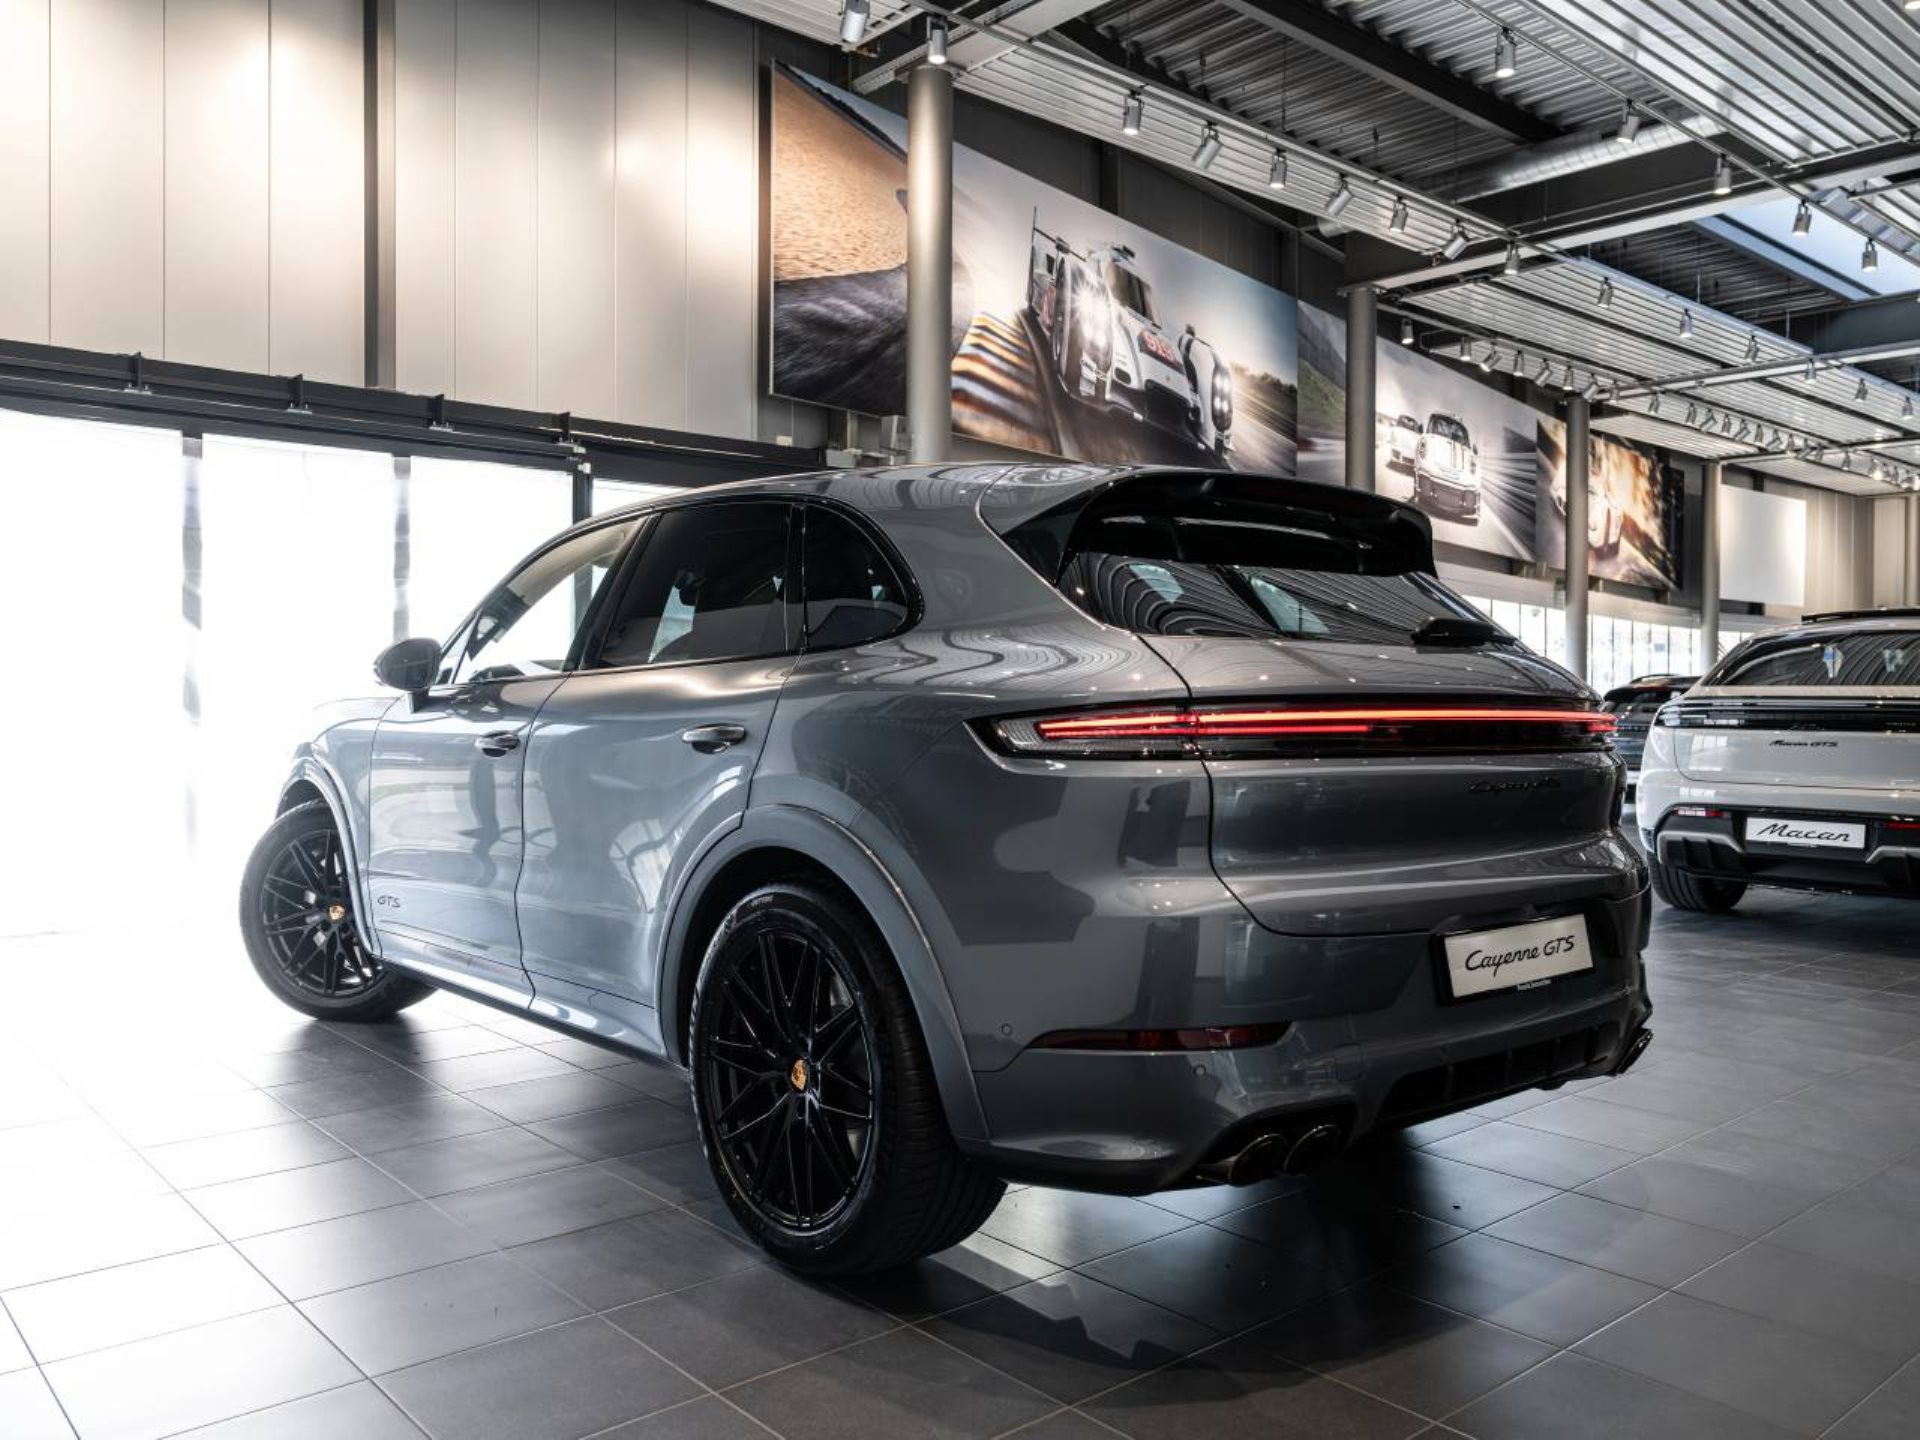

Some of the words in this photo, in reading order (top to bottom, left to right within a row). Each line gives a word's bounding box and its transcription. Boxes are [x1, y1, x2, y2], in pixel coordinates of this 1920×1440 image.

[1757, 822, 1851, 842] Macan
[377, 895, 401, 908] GTS
[1464, 946, 1540, 977] Cayenne
[1543, 935, 1576, 957] GTS
